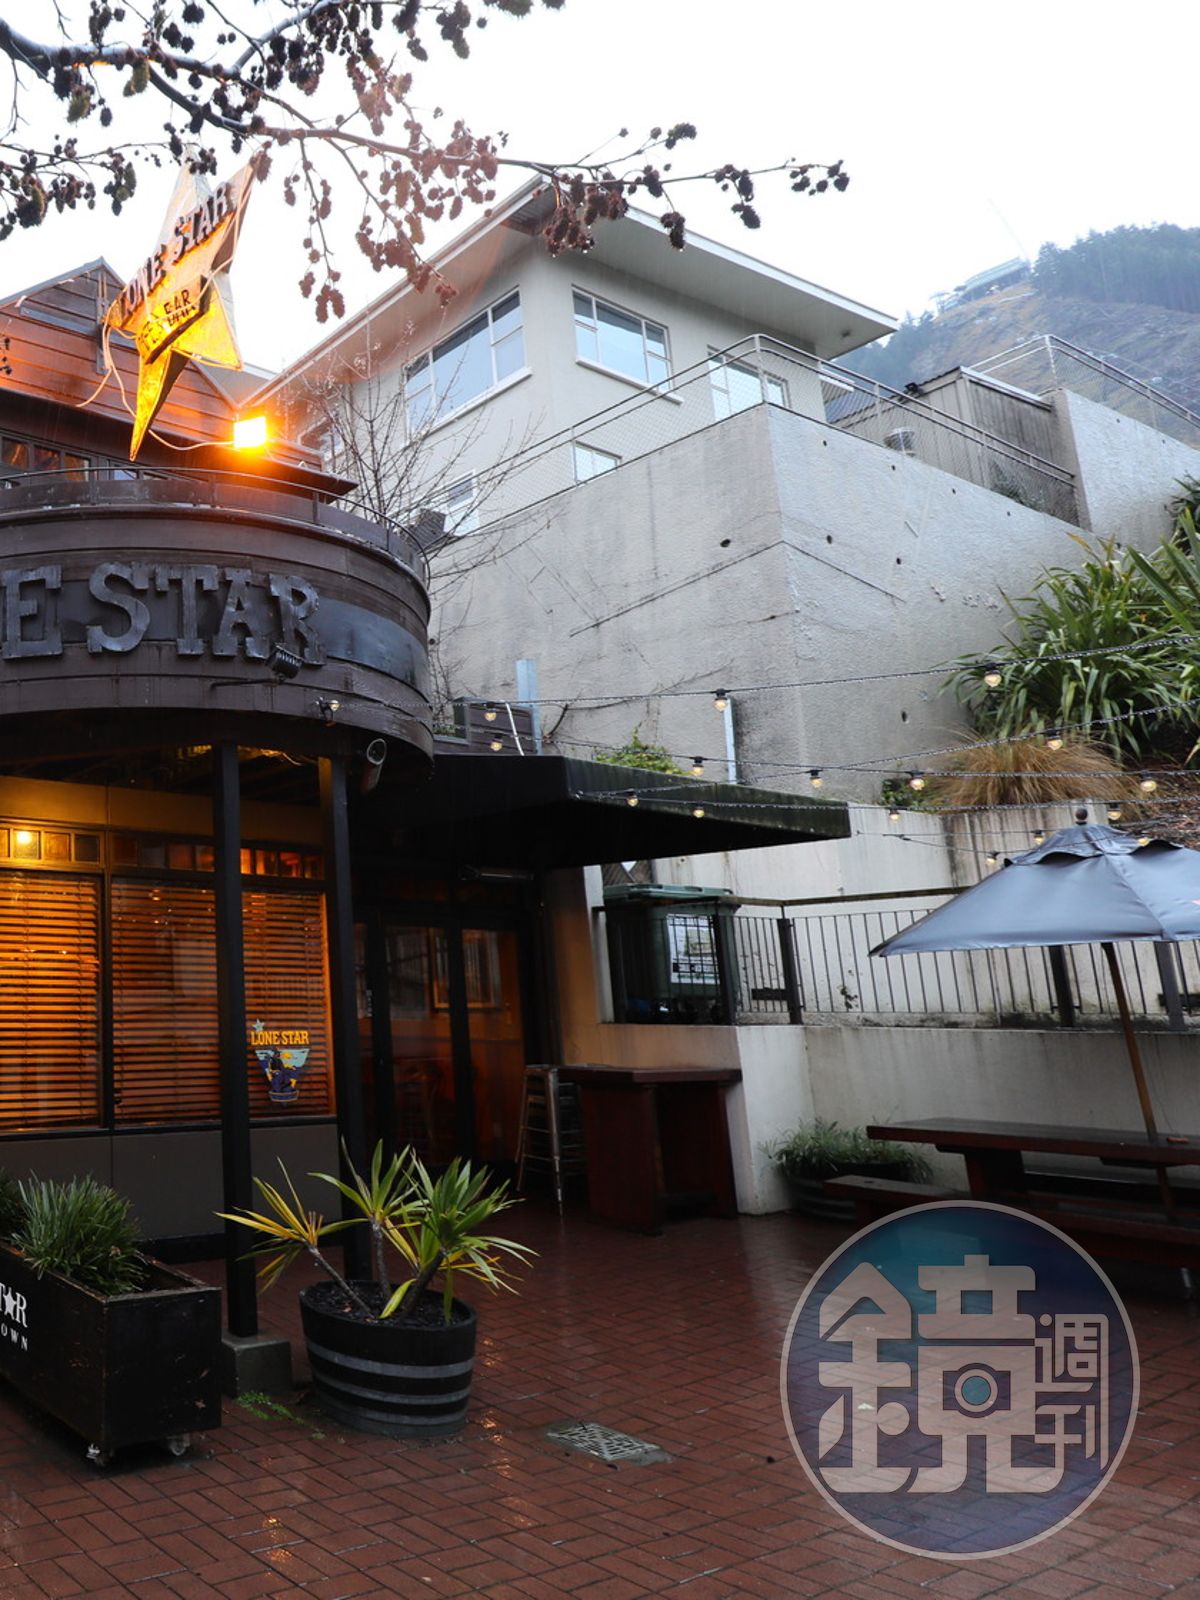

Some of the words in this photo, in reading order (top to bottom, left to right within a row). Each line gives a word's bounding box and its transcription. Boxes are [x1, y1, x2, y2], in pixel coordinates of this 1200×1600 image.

[172, 181, 237, 266] STAR
[86, 562, 327, 667] STAR
[251, 1030, 280, 1046] LONE
[281, 1030, 310, 1045] STAR
